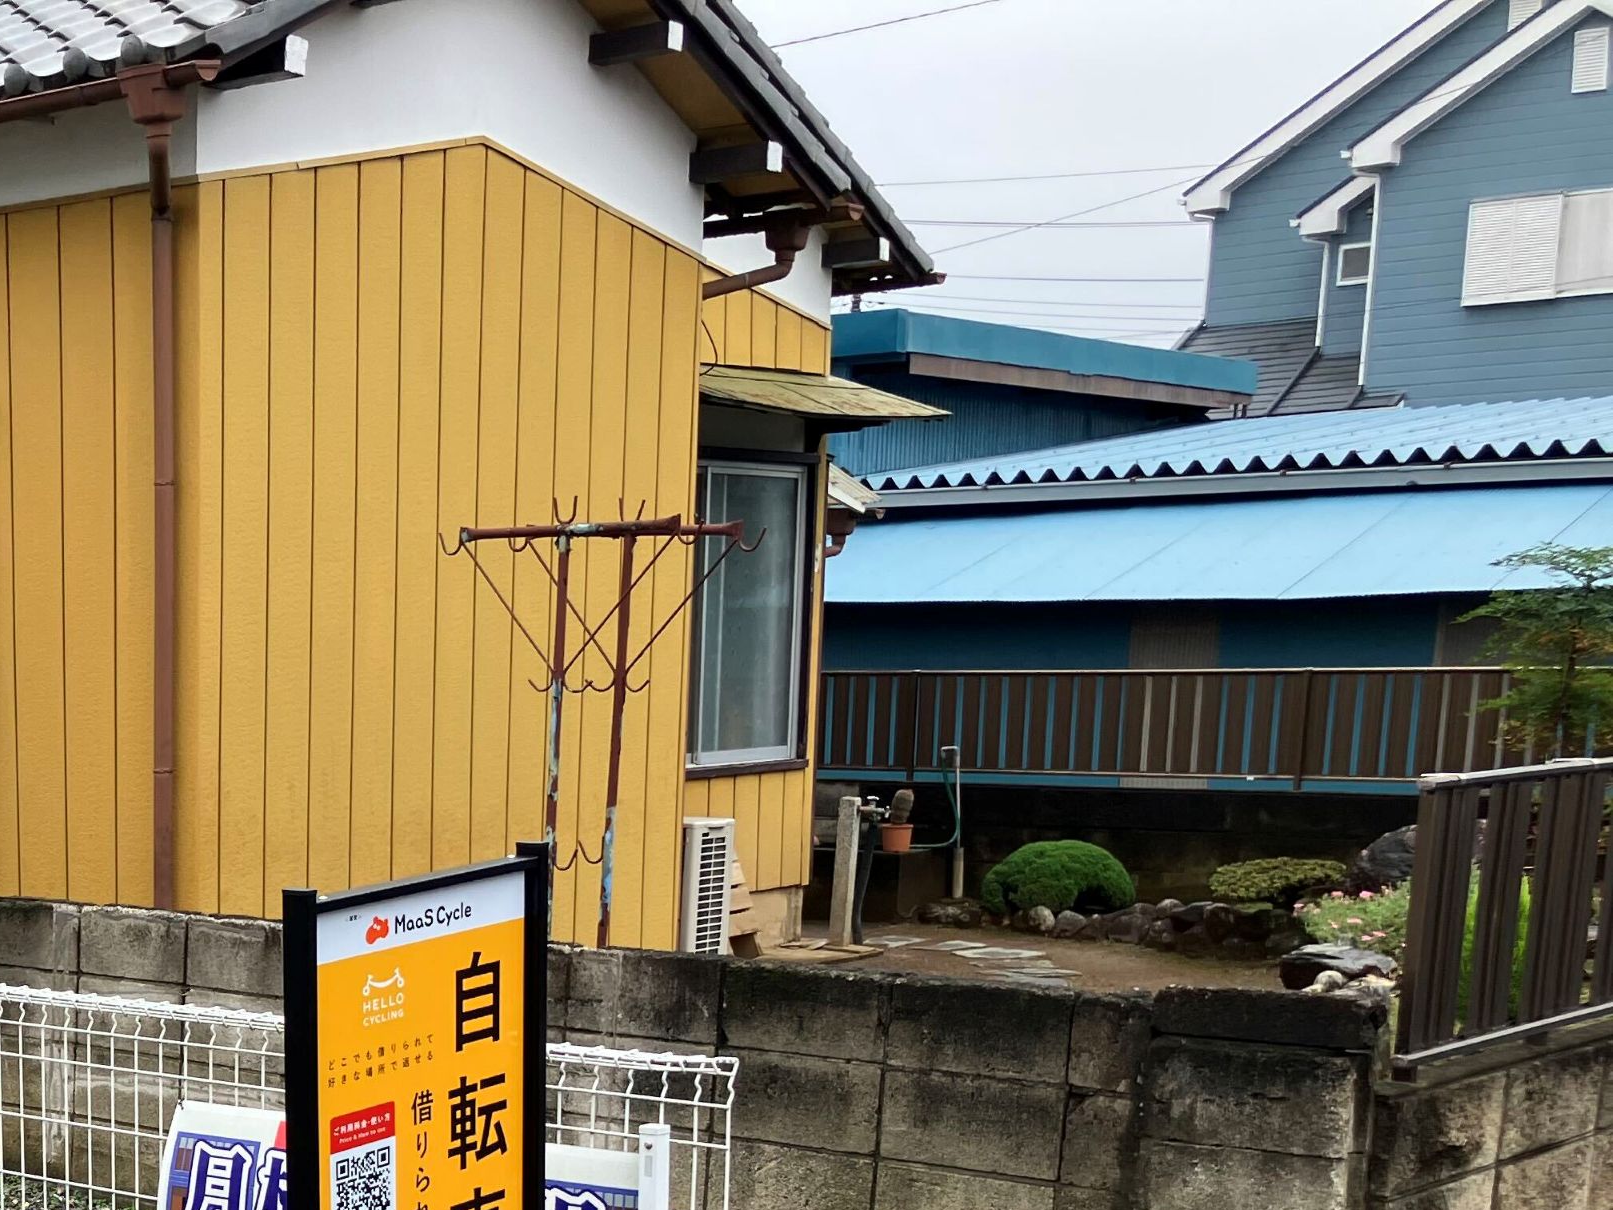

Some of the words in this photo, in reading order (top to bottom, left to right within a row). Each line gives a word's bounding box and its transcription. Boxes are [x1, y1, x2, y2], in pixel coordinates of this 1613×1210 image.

[394, 908, 434, 934] MaaS
[436, 902, 472, 926] Cycle
[362, 992, 404, 1013] HELLO
[362, 1008, 404, 1027] CYCLING
[328, 1034, 433, 1071] どこでも借りられて
